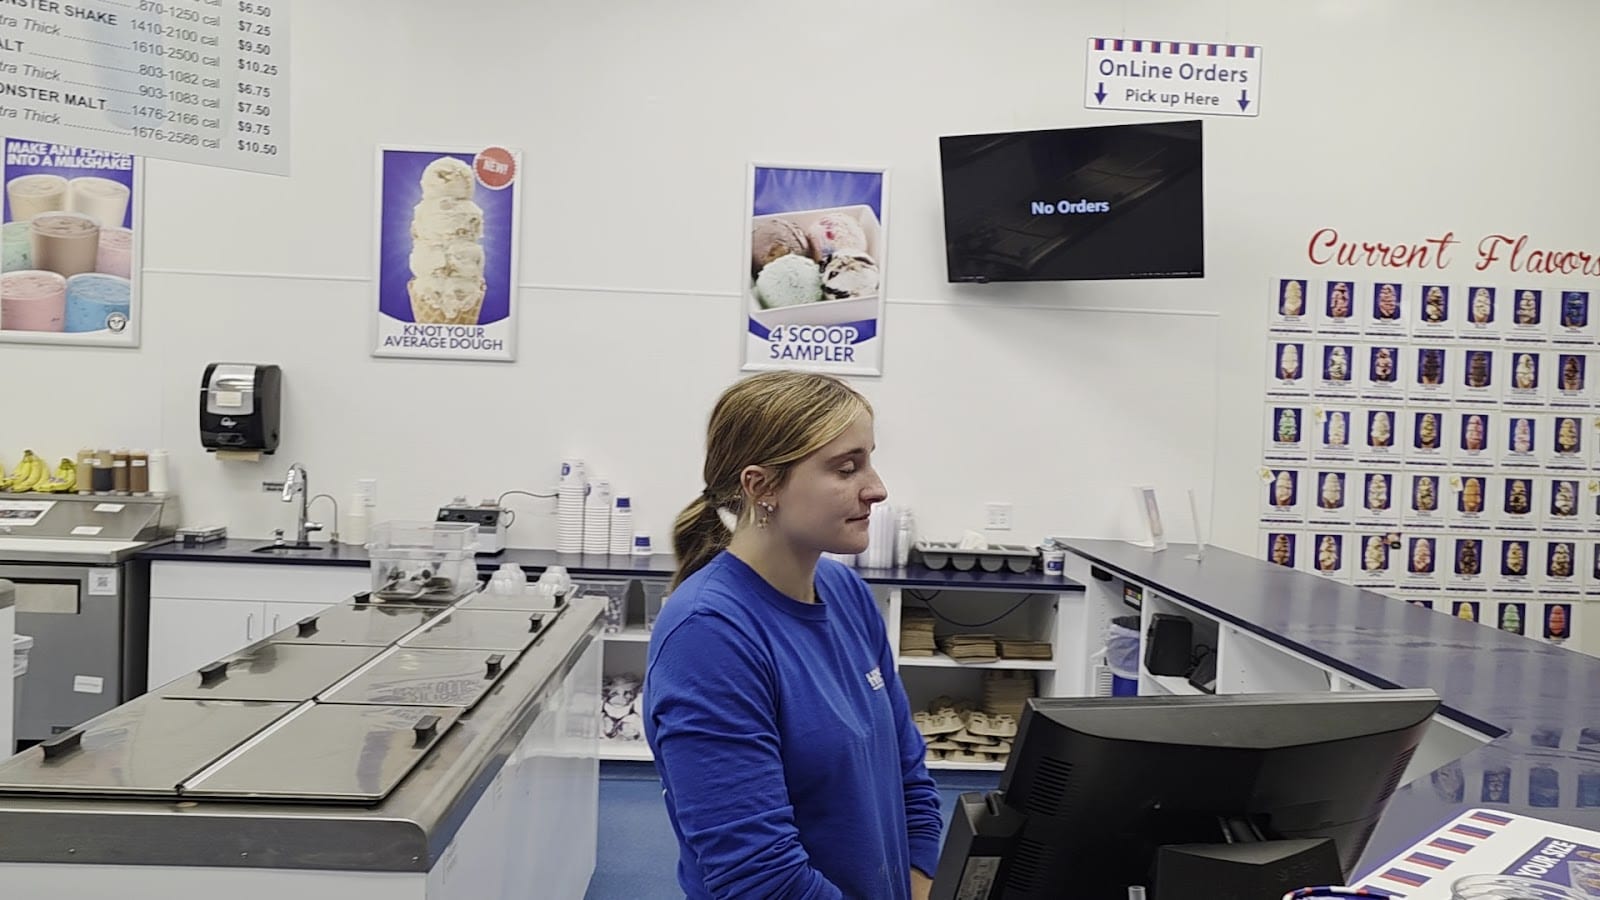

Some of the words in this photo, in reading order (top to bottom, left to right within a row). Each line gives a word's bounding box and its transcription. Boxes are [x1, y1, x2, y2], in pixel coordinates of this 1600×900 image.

[64, 5, 118, 26] SHAKE
[139, 0, 200, 22] 870-1250
[202, 16, 220, 26] cal
[238, 1, 271, 17] $6.50
[24, 18, 61, 36] Thick
[131, 19, 198, 42] 1410-2100
[201, 36, 219, 46] cal
[238, 20, 271, 36] $7.25
[132, 41, 199, 63] 1610-2500
[202, 56, 220, 67] cal
[238, 39, 271, 55] $9.50
[23, 64, 61, 81] Thick
[139, 64, 199, 85] 803-1082
[202, 78, 220, 88] cal
[238, 59, 278, 76] $10.25
[1099, 58, 1173, 79] OnLine
[1179, 62, 1249, 83] Orders
[138, 85, 199, 106] 903-1083
[202, 98, 220, 109] cal
[238, 82, 271, 98] $6.75
[1125, 88, 1157, 103] Pick
[1160, 93, 1180, 108] up
[1184, 91, 1220, 106] Here
[65, 93, 107, 110] MALT
[238, 101, 271, 116] $7.50
[24, 108, 60, 125] Thick
[132, 105, 199, 126] 1476-2166
[202, 118, 220, 129] cal
[238, 121, 271, 135] $9.75
[7, 142, 48, 155] MAKE
[49, 144, 78, 156] ANY
[202, 138, 220, 149] cal
[238, 140, 278, 156] $10.50
[7, 154, 40, 166] INTO
[42, 155, 53, 167] A
[483, 160, 508, 175] NEW!
[1031, 201, 1055, 215] No
[1057, 199, 1110, 214] Orders
[1308, 228, 1461, 270] Current
[403, 324, 443, 337] KNOT
[445, 326, 485, 338] YOUR
[771, 327, 783, 341] 4
[789, 327, 855, 344] SCOOP
[384, 336, 447, 349] AVERAGE
[450, 338, 503, 351] DOUGH
[770, 344, 855, 362] SAMPLER
[1513, 855, 1561, 879] YOUR
[1540, 840, 1577, 858] SIZE
